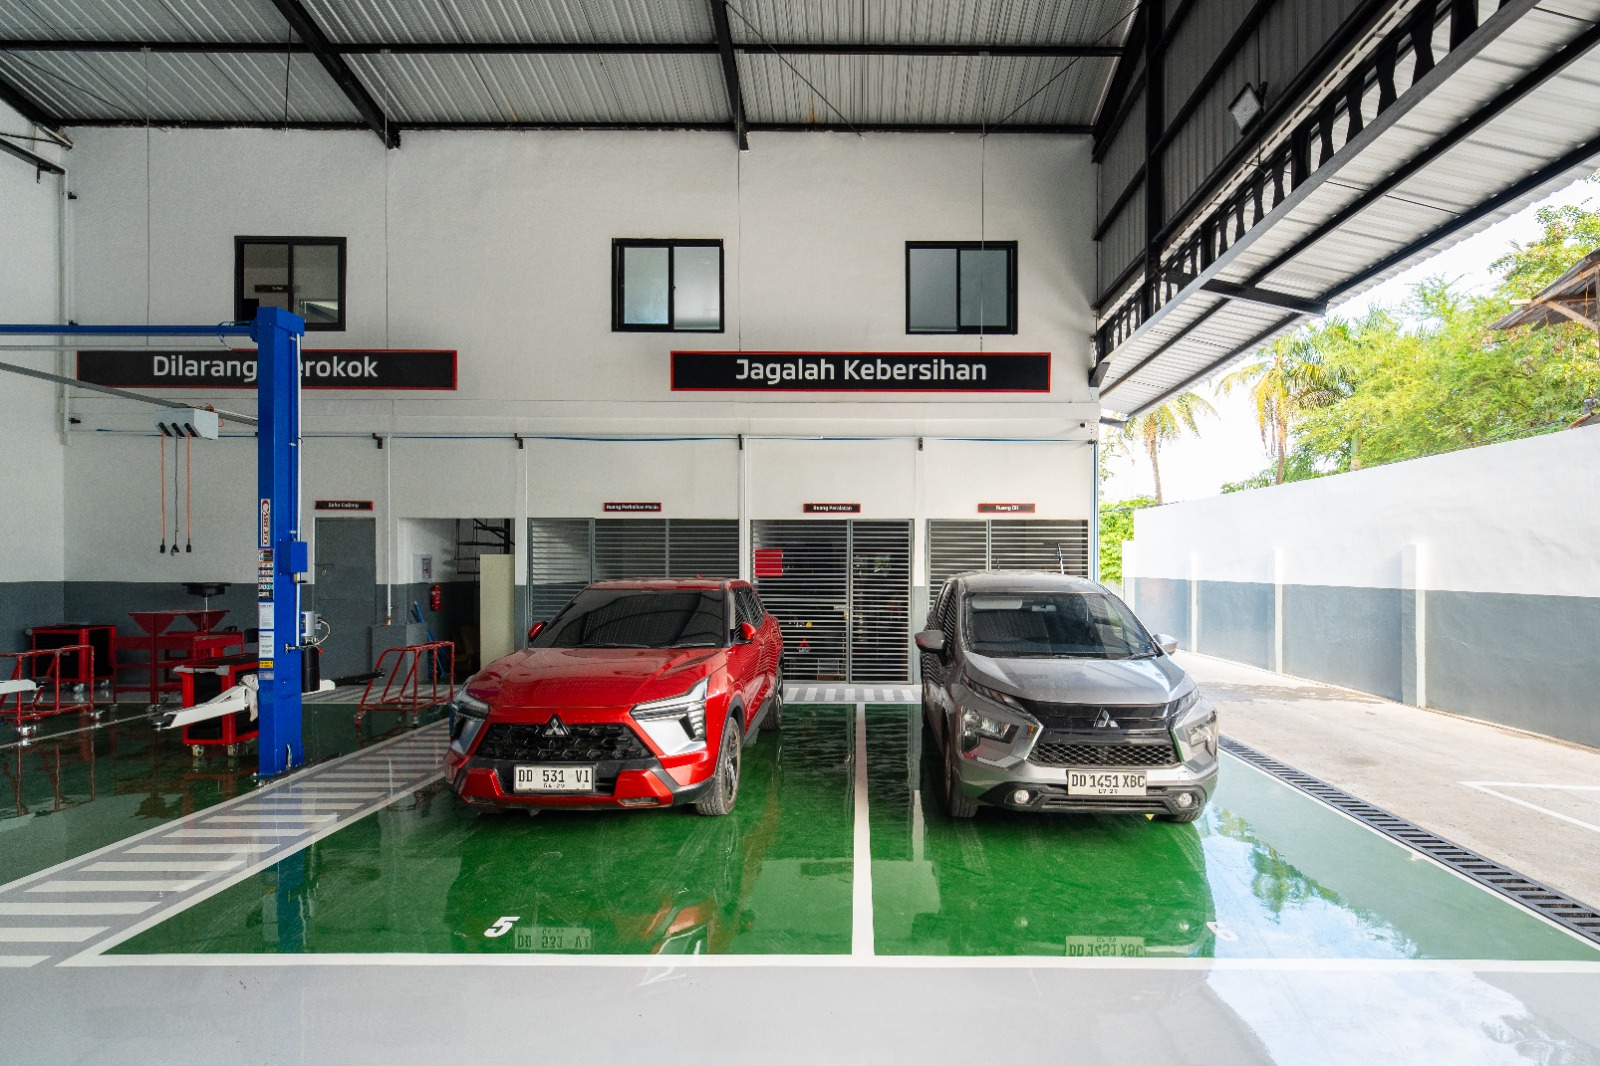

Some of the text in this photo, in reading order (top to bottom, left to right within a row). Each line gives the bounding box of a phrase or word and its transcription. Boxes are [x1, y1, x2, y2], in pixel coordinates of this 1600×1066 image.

[153, 355, 379, 382] Dilarang rokok
[735, 358, 987, 385] Jagalah Kebersihan
[518, 769, 590, 783] DD 531 VI
[1071, 773, 1145, 788] DD 1451 XBC
[484, 916, 520, 938] 5
